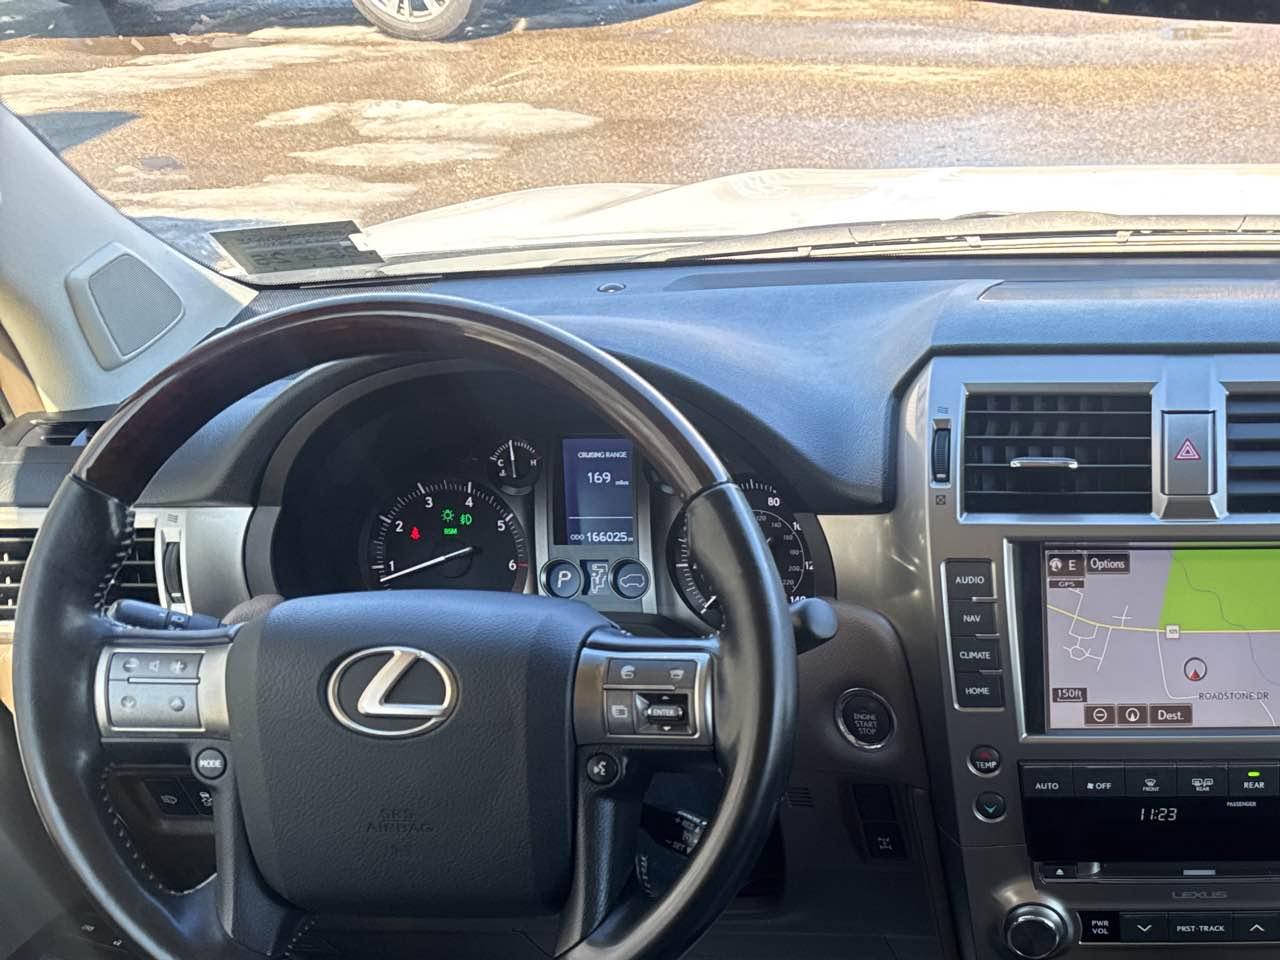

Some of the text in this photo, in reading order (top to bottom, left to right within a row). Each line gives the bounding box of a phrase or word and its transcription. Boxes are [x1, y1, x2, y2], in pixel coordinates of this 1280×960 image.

[587, 471, 611, 484] 169
[425, 498, 433, 508] 3
[465, 497, 474, 508] 4
[767, 497, 780, 507] 80
[395, 521, 403, 532] 2
[497, 521, 505, 531] 5
[570, 533, 585, 541] ODO
[586, 531, 628, 542] 166025
[388, 561, 395, 571] 1
[508, 560, 516, 571] 6
[1069, 559, 1076, 571] E
[1090, 557, 1125, 570] Options
[557, 570, 572, 588] P
[955, 575, 985, 585] AUDIO
[1058, 580, 1076, 588] GPS
[963, 614, 981, 623] NAV
[959, 651, 991, 660] CLIMATE
[965, 686, 990, 696] HOME
[1057, 688, 1083, 699] 150ft
[1198, 691, 1270, 701] ROADSTONE DR
[652, 708, 675, 717] ENTER
[853, 713, 878, 721] ENGINE
[1157, 709, 1185, 720] Dest.
[854, 720, 878, 729] START
[858, 727, 877, 735] STOP
[199, 759, 221, 768] MODE
[975, 760, 997, 769] TEMP
[1035, 782, 1059, 790] AUTO
[1095, 782, 1112, 790] OFF
[1243, 781, 1265, 789] REAR
[1140, 807, 1177, 821] 11:23
[1171, 890, 1229, 899] LEXUS
[1091, 919, 1109, 927] PWR
[1091, 927, 1109, 935] VOL
